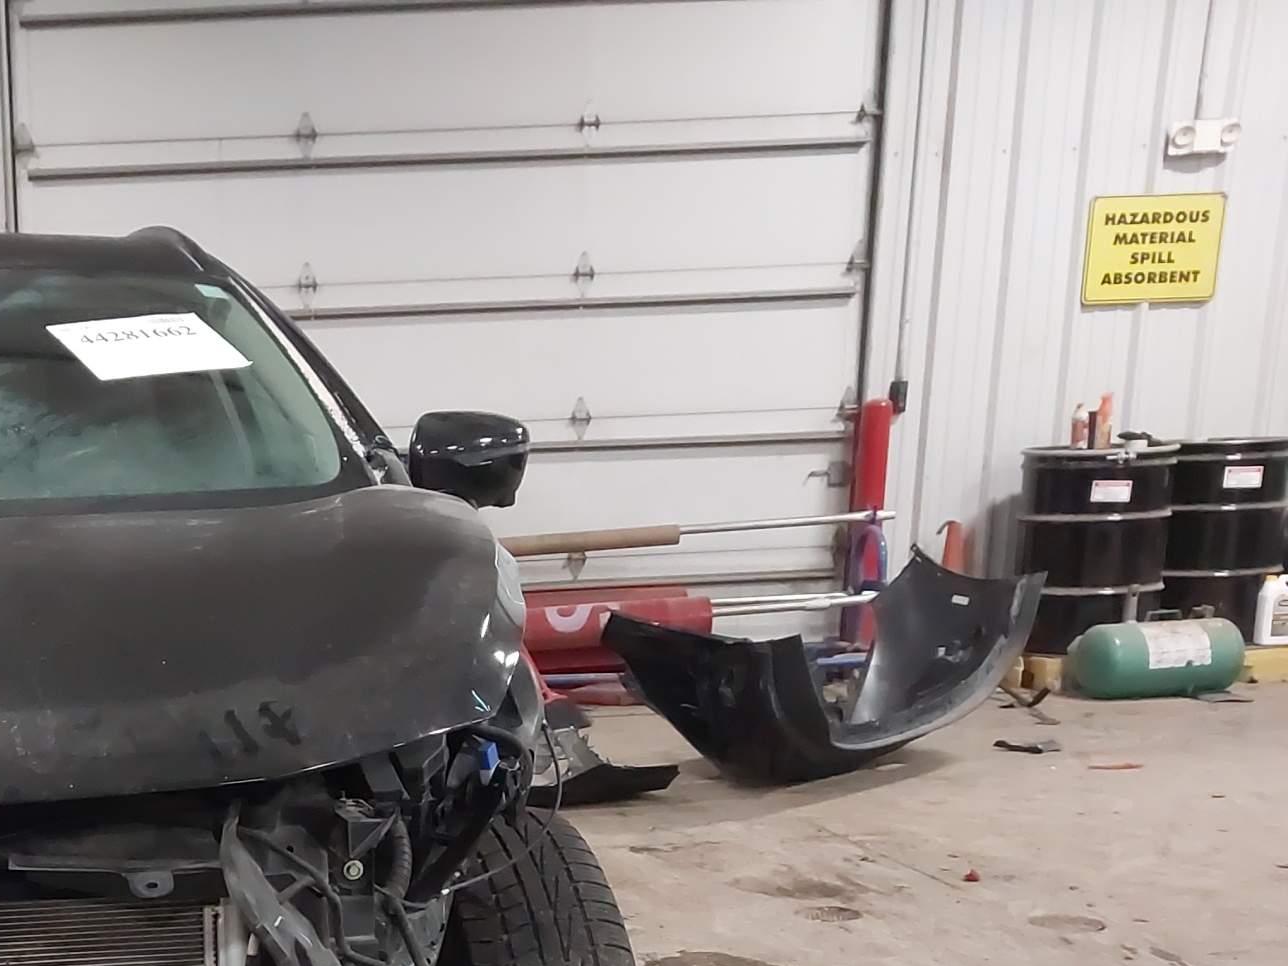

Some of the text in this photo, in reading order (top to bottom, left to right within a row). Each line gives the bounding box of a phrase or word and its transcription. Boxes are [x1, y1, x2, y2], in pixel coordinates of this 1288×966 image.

[1105, 210, 1210, 225] HAZARDOUS
[1113, 231, 1195, 245] MATERIAL
[1129, 251, 1175, 265] SPILL
[1100, 270, 1201, 285] ABSORBENT
[80, 325, 198, 345] 44281662
